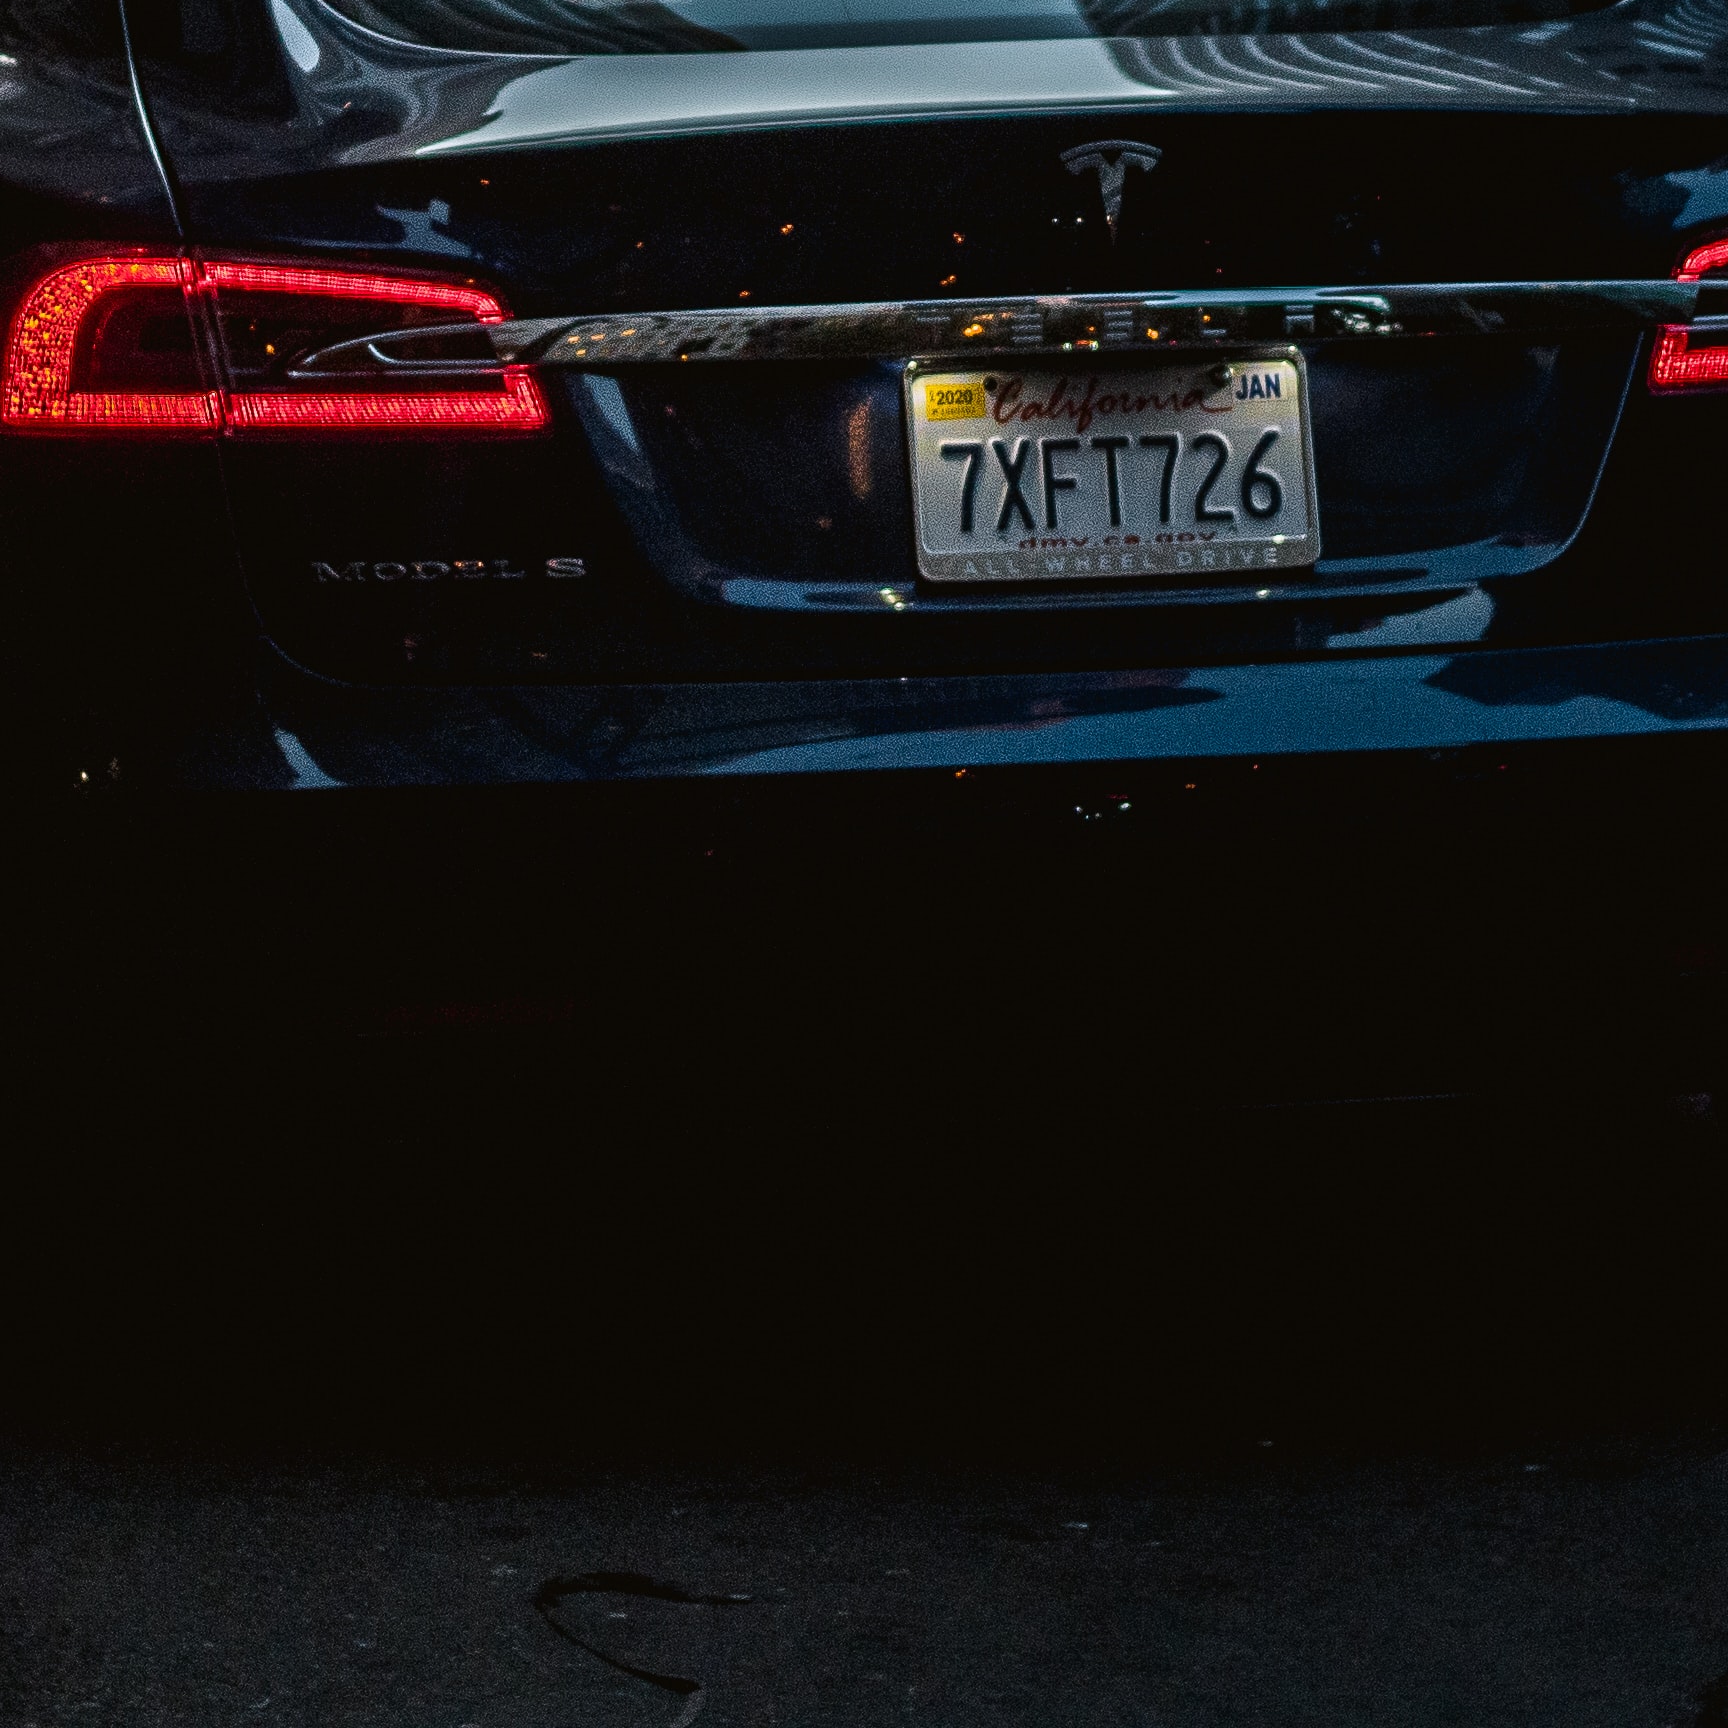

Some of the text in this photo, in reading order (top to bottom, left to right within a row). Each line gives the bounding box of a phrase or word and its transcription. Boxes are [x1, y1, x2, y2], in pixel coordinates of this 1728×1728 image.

[936, 388, 973, 406] 2020
[1236, 374, 1280, 400] JAN
[993, 376, 1232, 432] California
[940, 429, 1284, 532] 7XFT726
[312, 556, 587, 583] MODEL S
[1046, 551, 1154, 572] WHEEL
[1178, 546, 1277, 567] DRIVE
